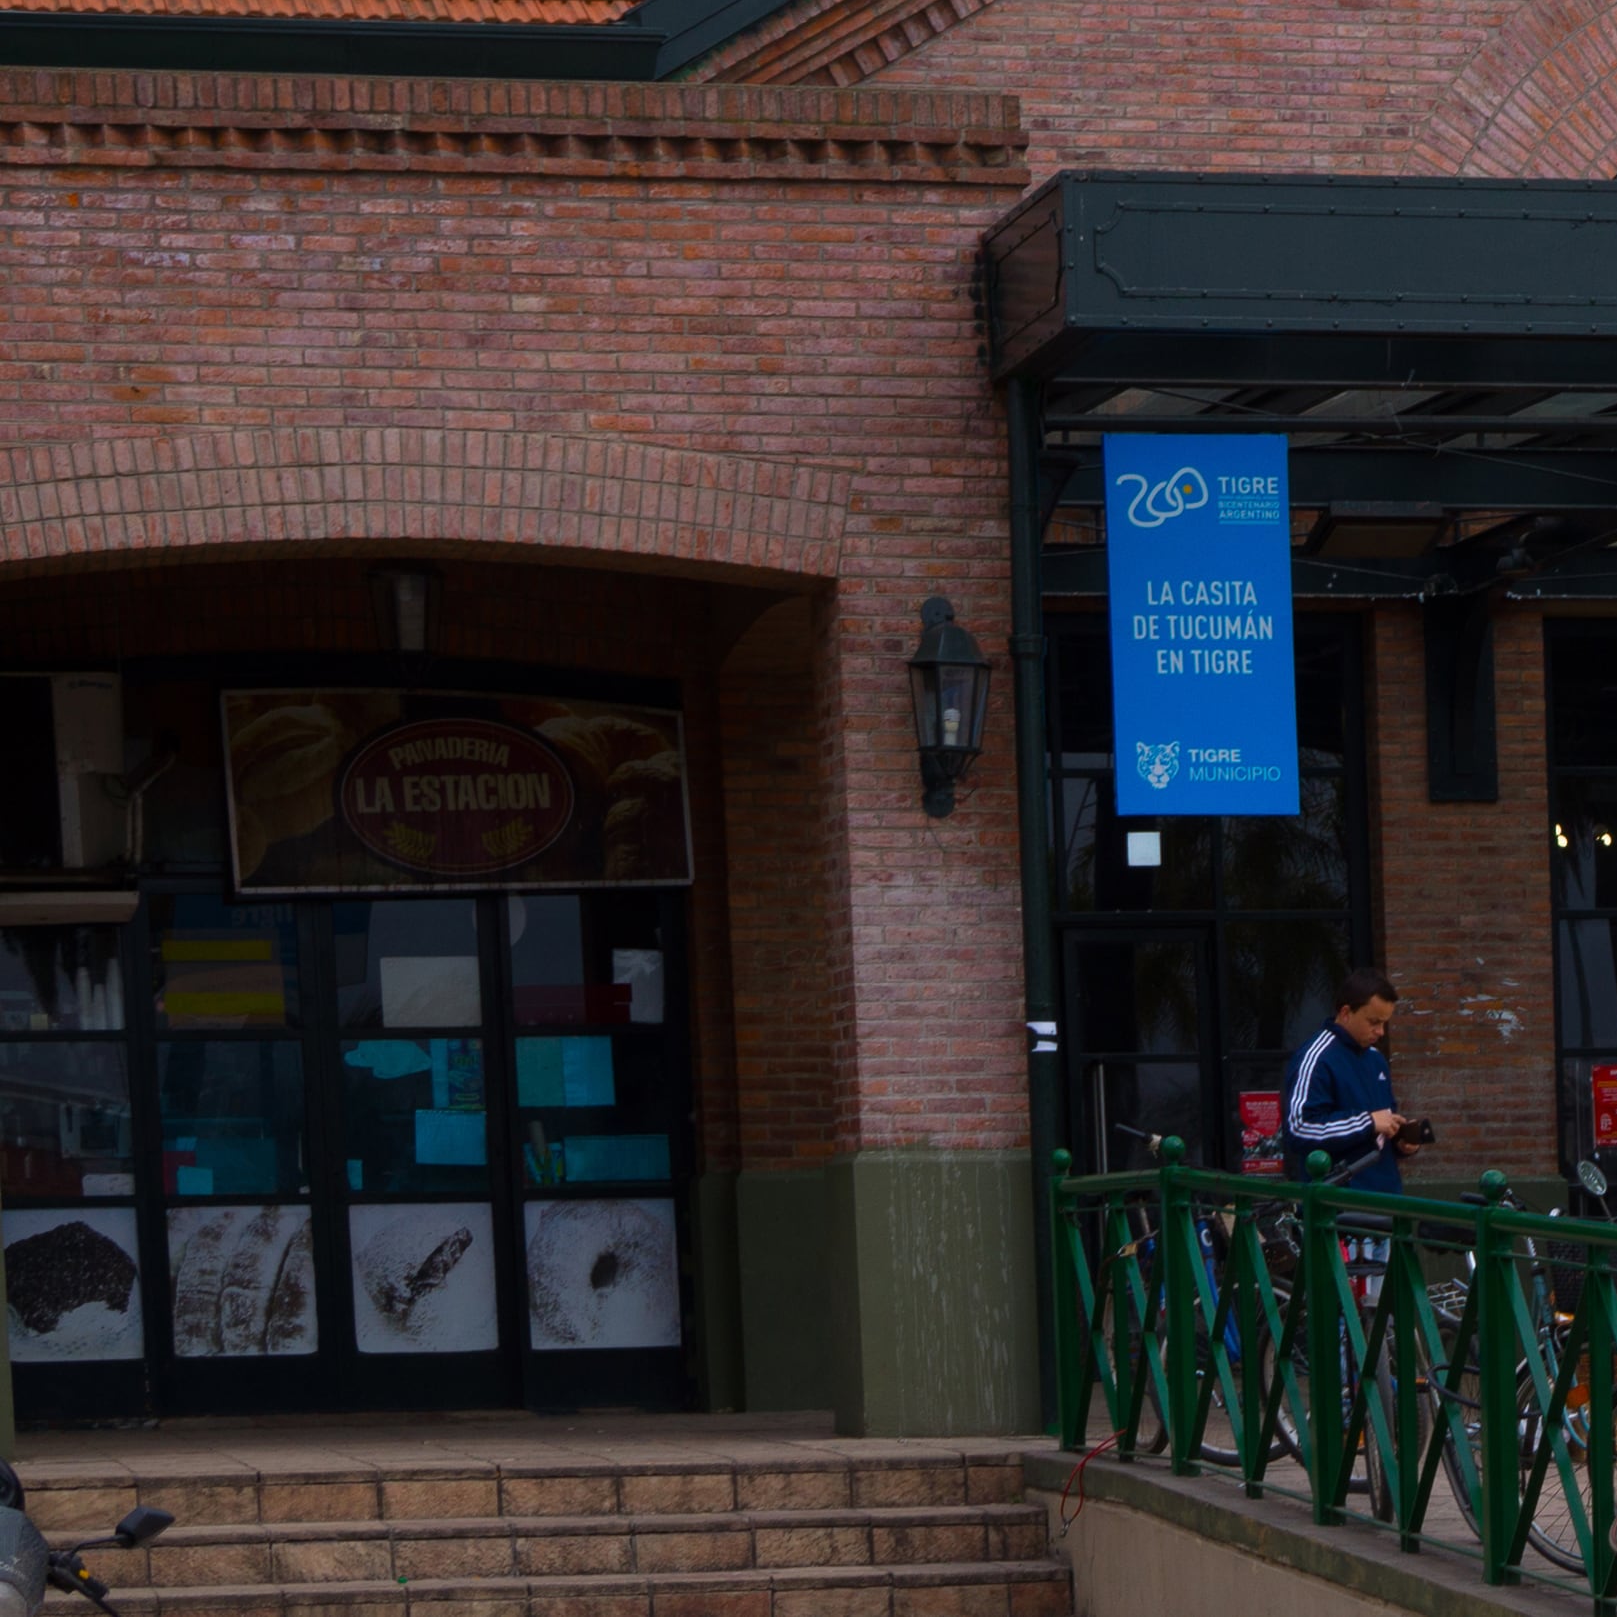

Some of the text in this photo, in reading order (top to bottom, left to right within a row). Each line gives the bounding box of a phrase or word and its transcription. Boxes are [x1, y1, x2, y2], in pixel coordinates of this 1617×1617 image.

[1217, 476, 1279, 494] TIGRE
[1219, 509, 1280, 520] ARGENTINO
[1147, 581, 1258, 606] LA CASITA
[1133, 608, 1273, 641] DE TUCUMÁN
[1157, 650, 1253, 675] EN TIGRE
[388, 736, 511, 771] PANADERIA
[1188, 748, 1241, 763] TIGRE
[1189, 766, 1281, 783] MUNICIPIO
[355, 773, 552, 814] LA ESTACION
